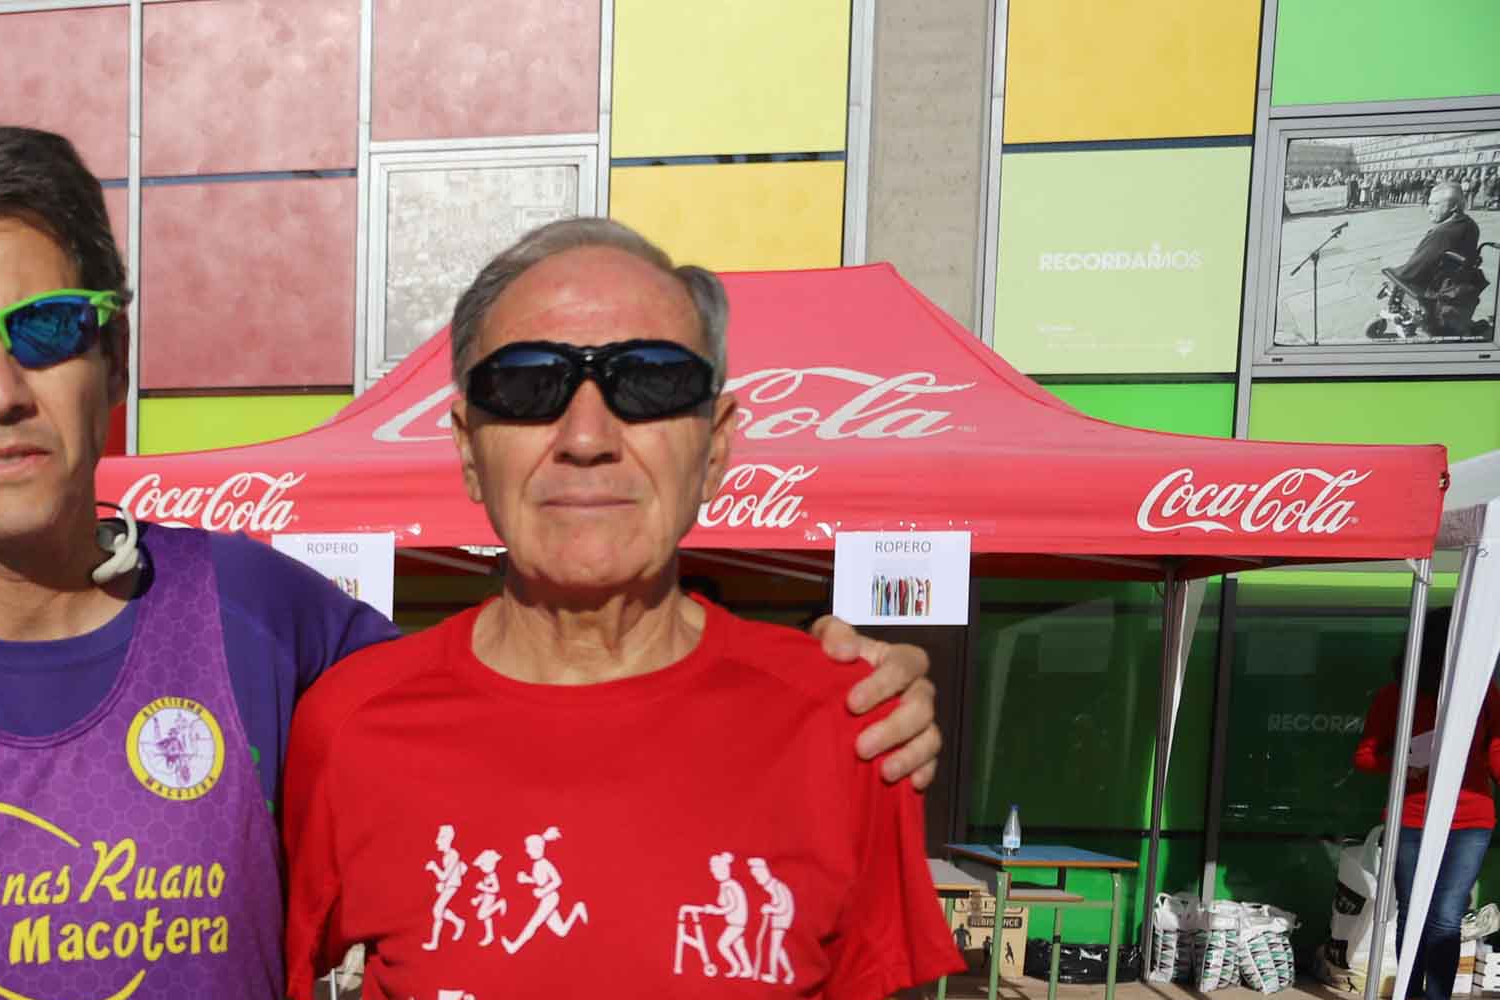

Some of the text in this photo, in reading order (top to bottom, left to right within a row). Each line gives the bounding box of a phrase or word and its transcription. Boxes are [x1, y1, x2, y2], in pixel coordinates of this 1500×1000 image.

[116, 471, 306, 532] Coca-Cola
[1137, 468, 1373, 534] Coca-Cola
[306, 542, 358, 555] ROPERO
[874, 541, 932, 553] ROPERO
[79, 838, 226, 902] Ruano
[8, 907, 229, 965] Macotera
